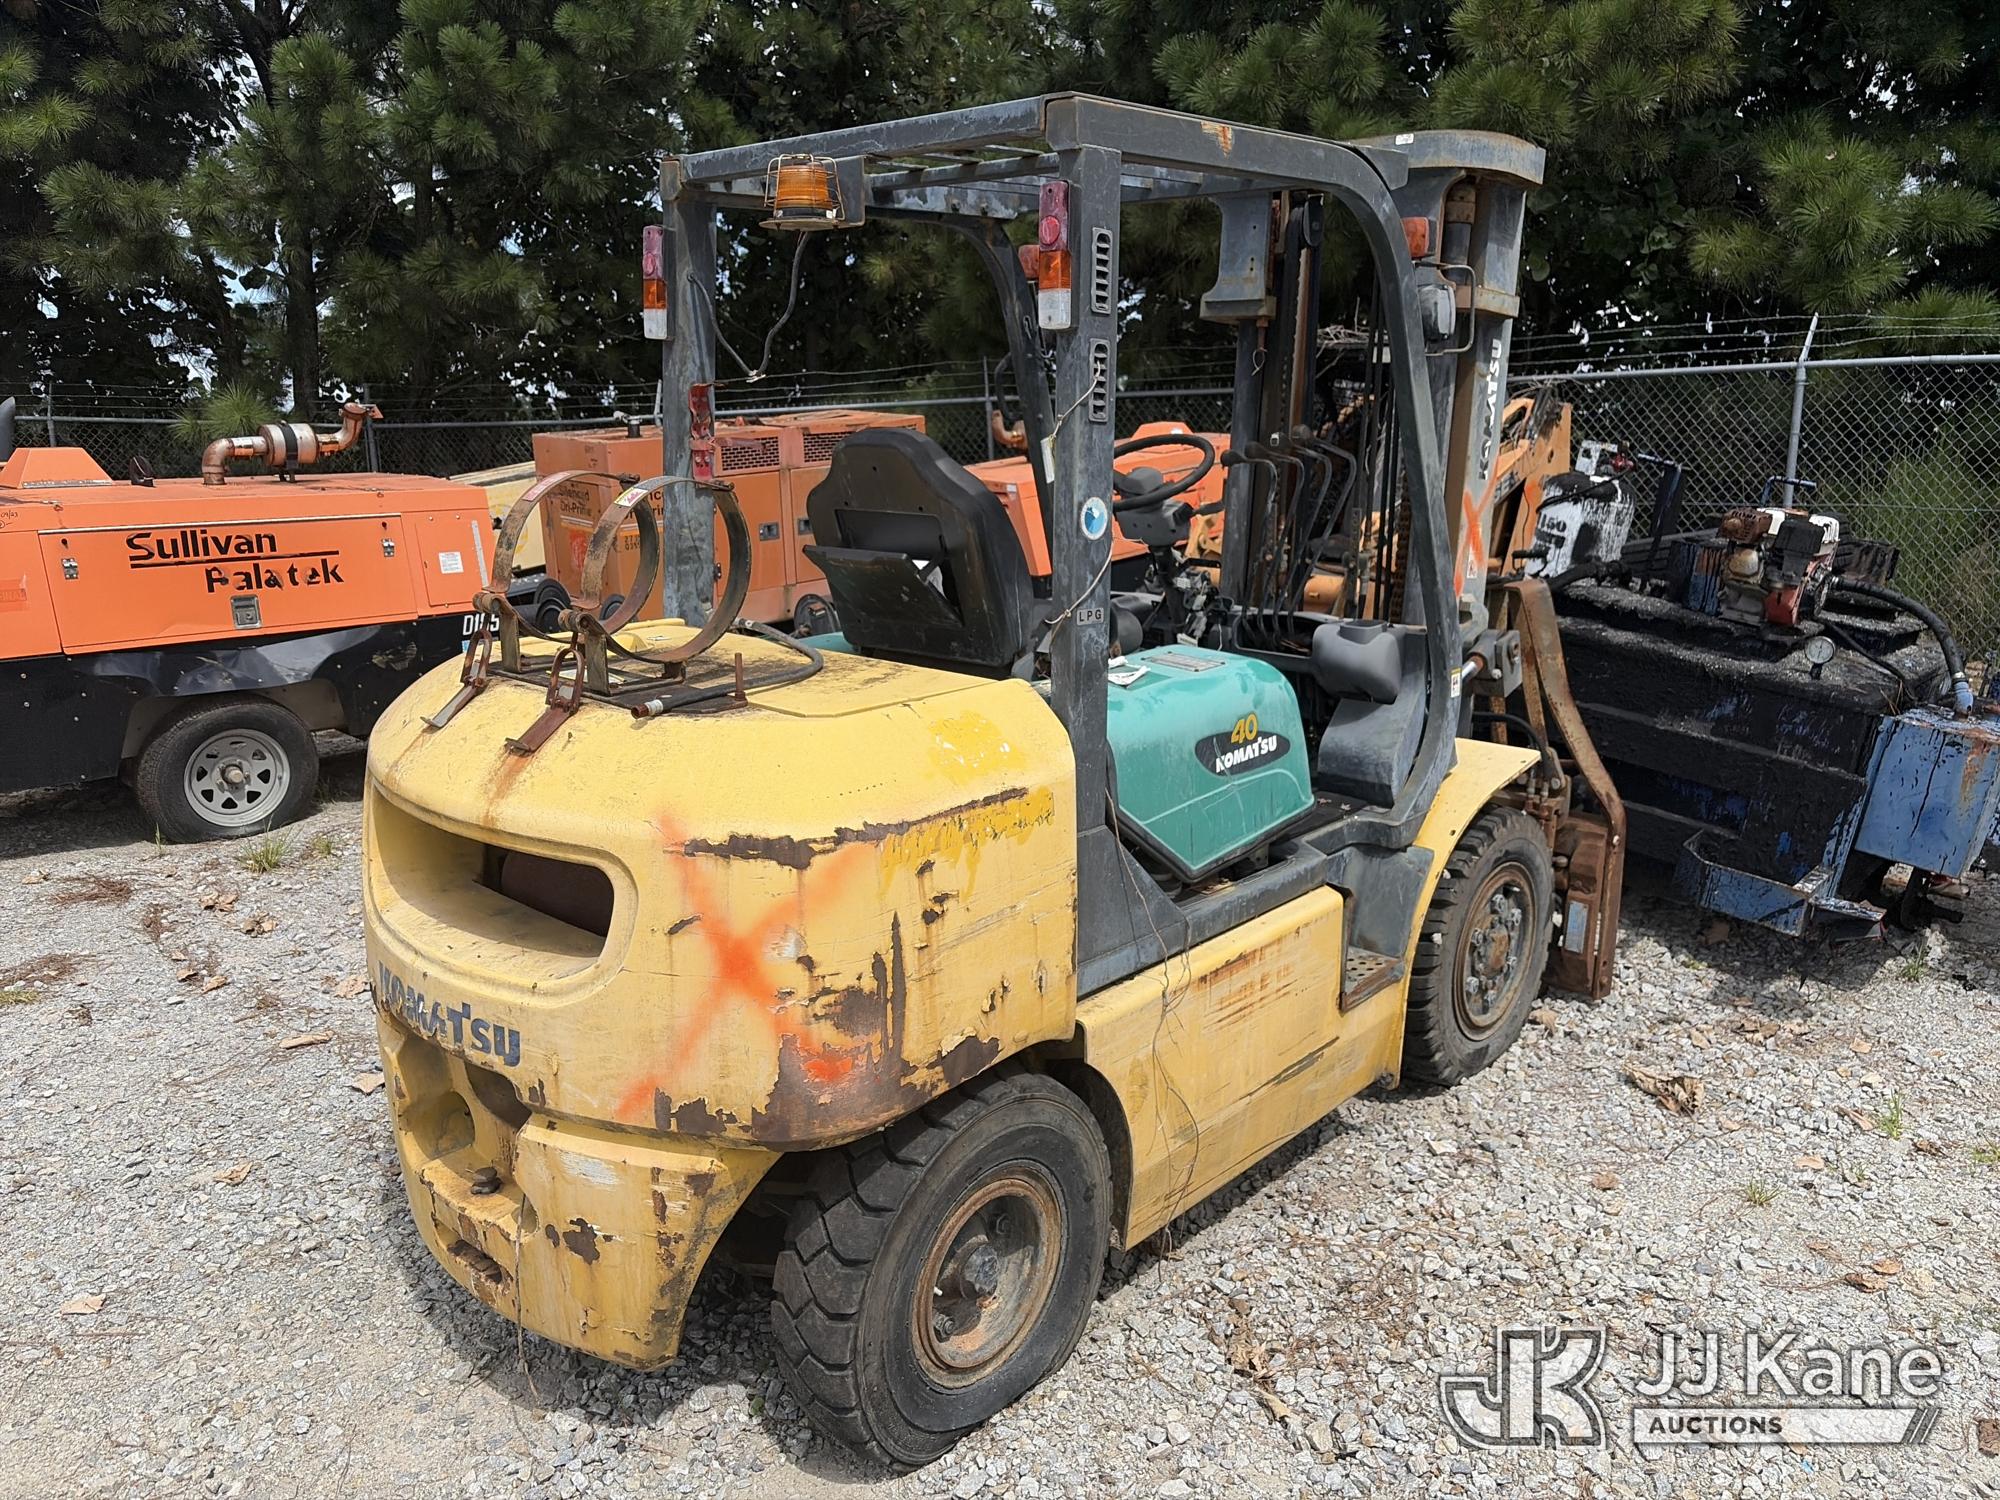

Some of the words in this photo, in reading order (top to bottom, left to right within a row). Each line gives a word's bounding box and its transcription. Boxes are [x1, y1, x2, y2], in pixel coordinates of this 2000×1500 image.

[1478, 338, 1502, 481] KOMATSU
[126, 529, 278, 562] Sullivan
[205, 557, 344, 593] Palatek
[1078, 609, 1103, 623] LPG
[1230, 713, 1258, 744] 40
[1215, 735, 1278, 773] KOMATSU
[378, 960, 521, 1068] KOMATSU
